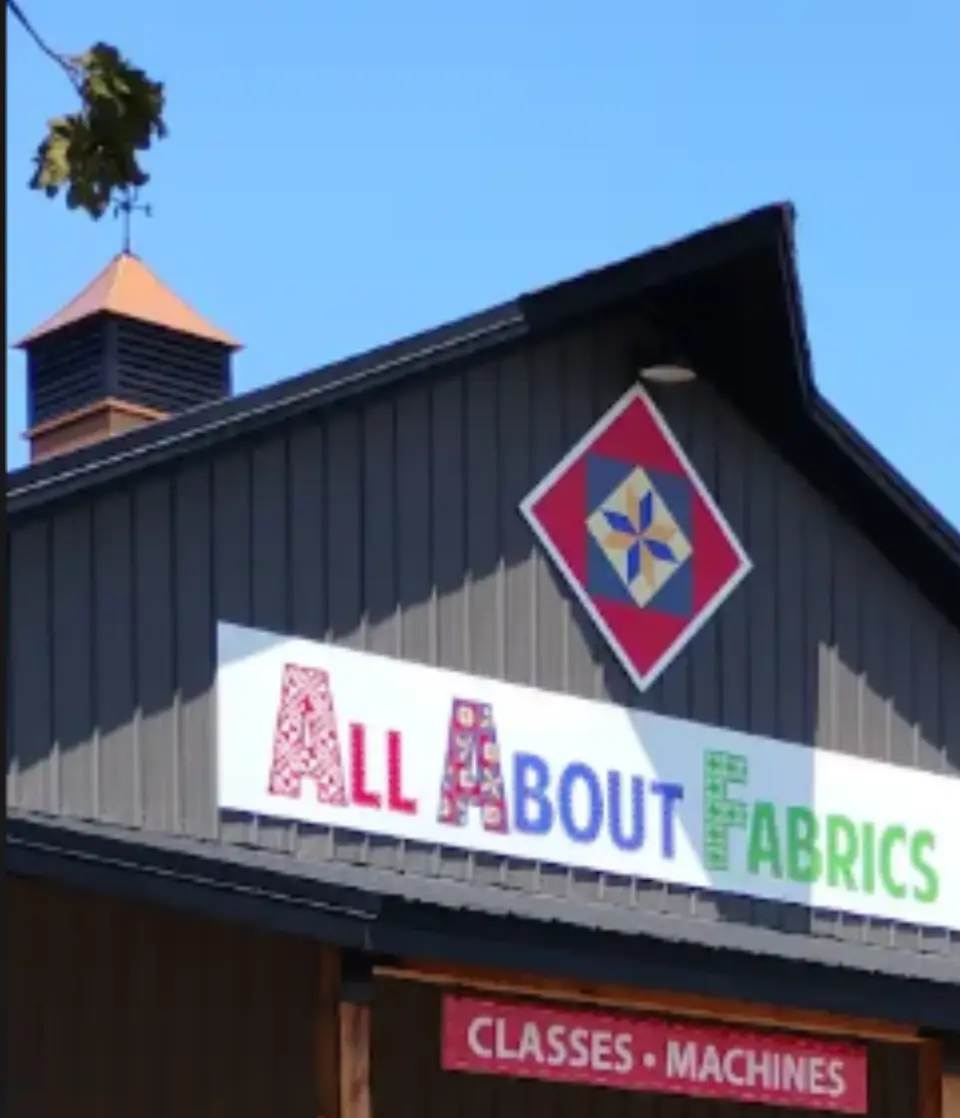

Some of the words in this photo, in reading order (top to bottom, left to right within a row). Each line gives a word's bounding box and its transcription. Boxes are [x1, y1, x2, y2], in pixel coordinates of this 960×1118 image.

[267, 662, 418, 814] ALL
[437, 697, 683, 858] ABOUT
[704, 749, 940, 904] FABRICS
[467, 1017, 633, 1074] CLASSES
[666, 1040, 847, 1098] MACHINES
